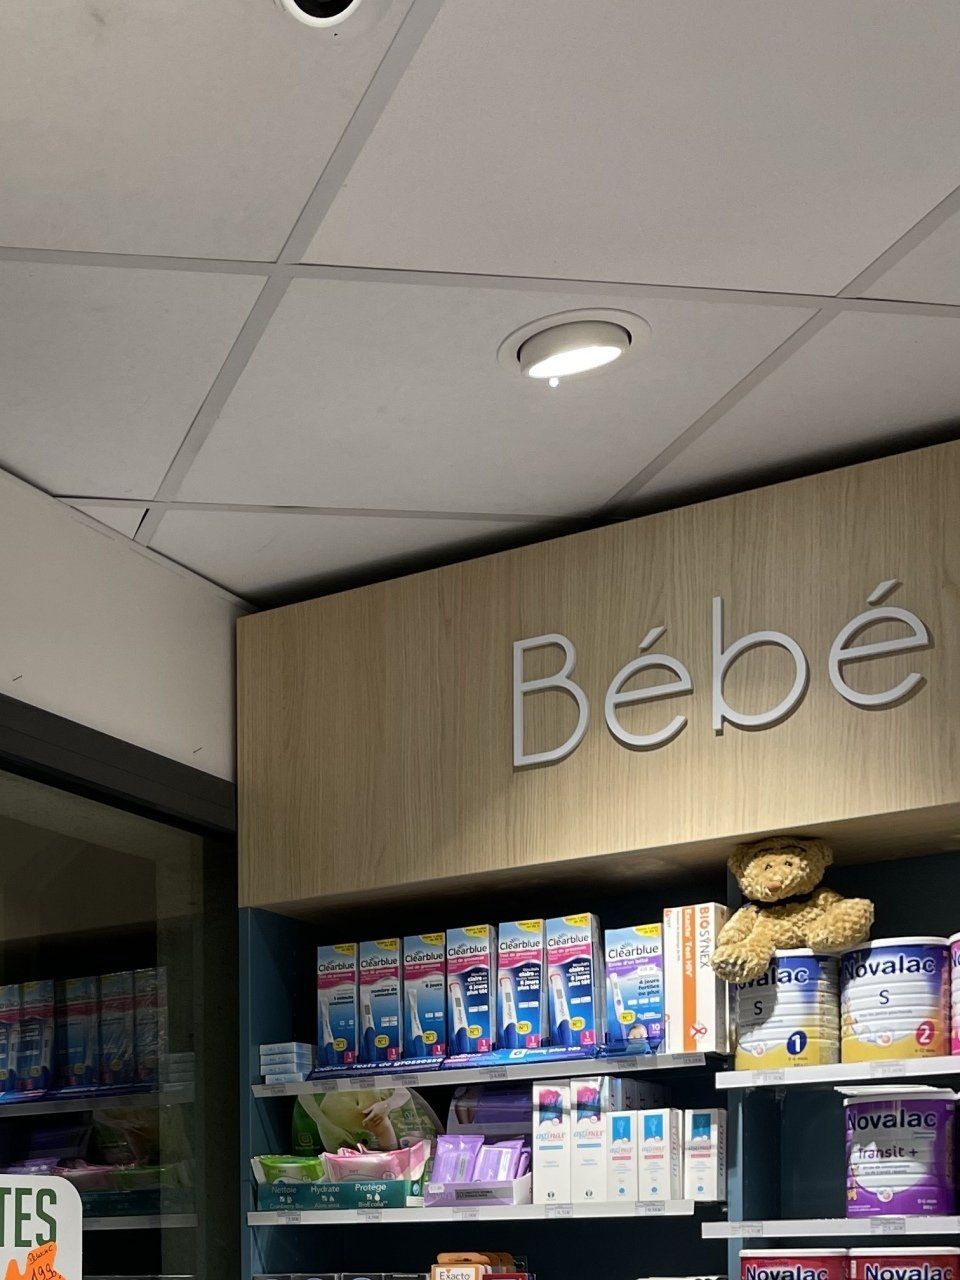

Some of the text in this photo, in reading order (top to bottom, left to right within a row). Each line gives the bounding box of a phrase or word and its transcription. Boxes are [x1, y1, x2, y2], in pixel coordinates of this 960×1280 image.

[513, 578, 933, 768] Bébé
[499, 938, 541, 951] Clearblue
[547, 933, 590, 948] Clearblue
[699, 906, 711, 968] BIOSYNEX
[404, 951, 444, 964] Clearblue
[448, 943, 488, 957] Clearblue
[608, 943, 660, 960] Clearblue
[843, 954, 937, 981] Novalac
[878, 988, 890, 1005] S
[753, 1000, 763, 1016] S
[918, 1024, 931, 1043] 2
[791, 1033, 802, 1053] 1
[310, 1184, 340, 1195] Hydrate
[354, 1182, 387, 1193] Protège
[439, 1271, 471, 1280] Exacto
